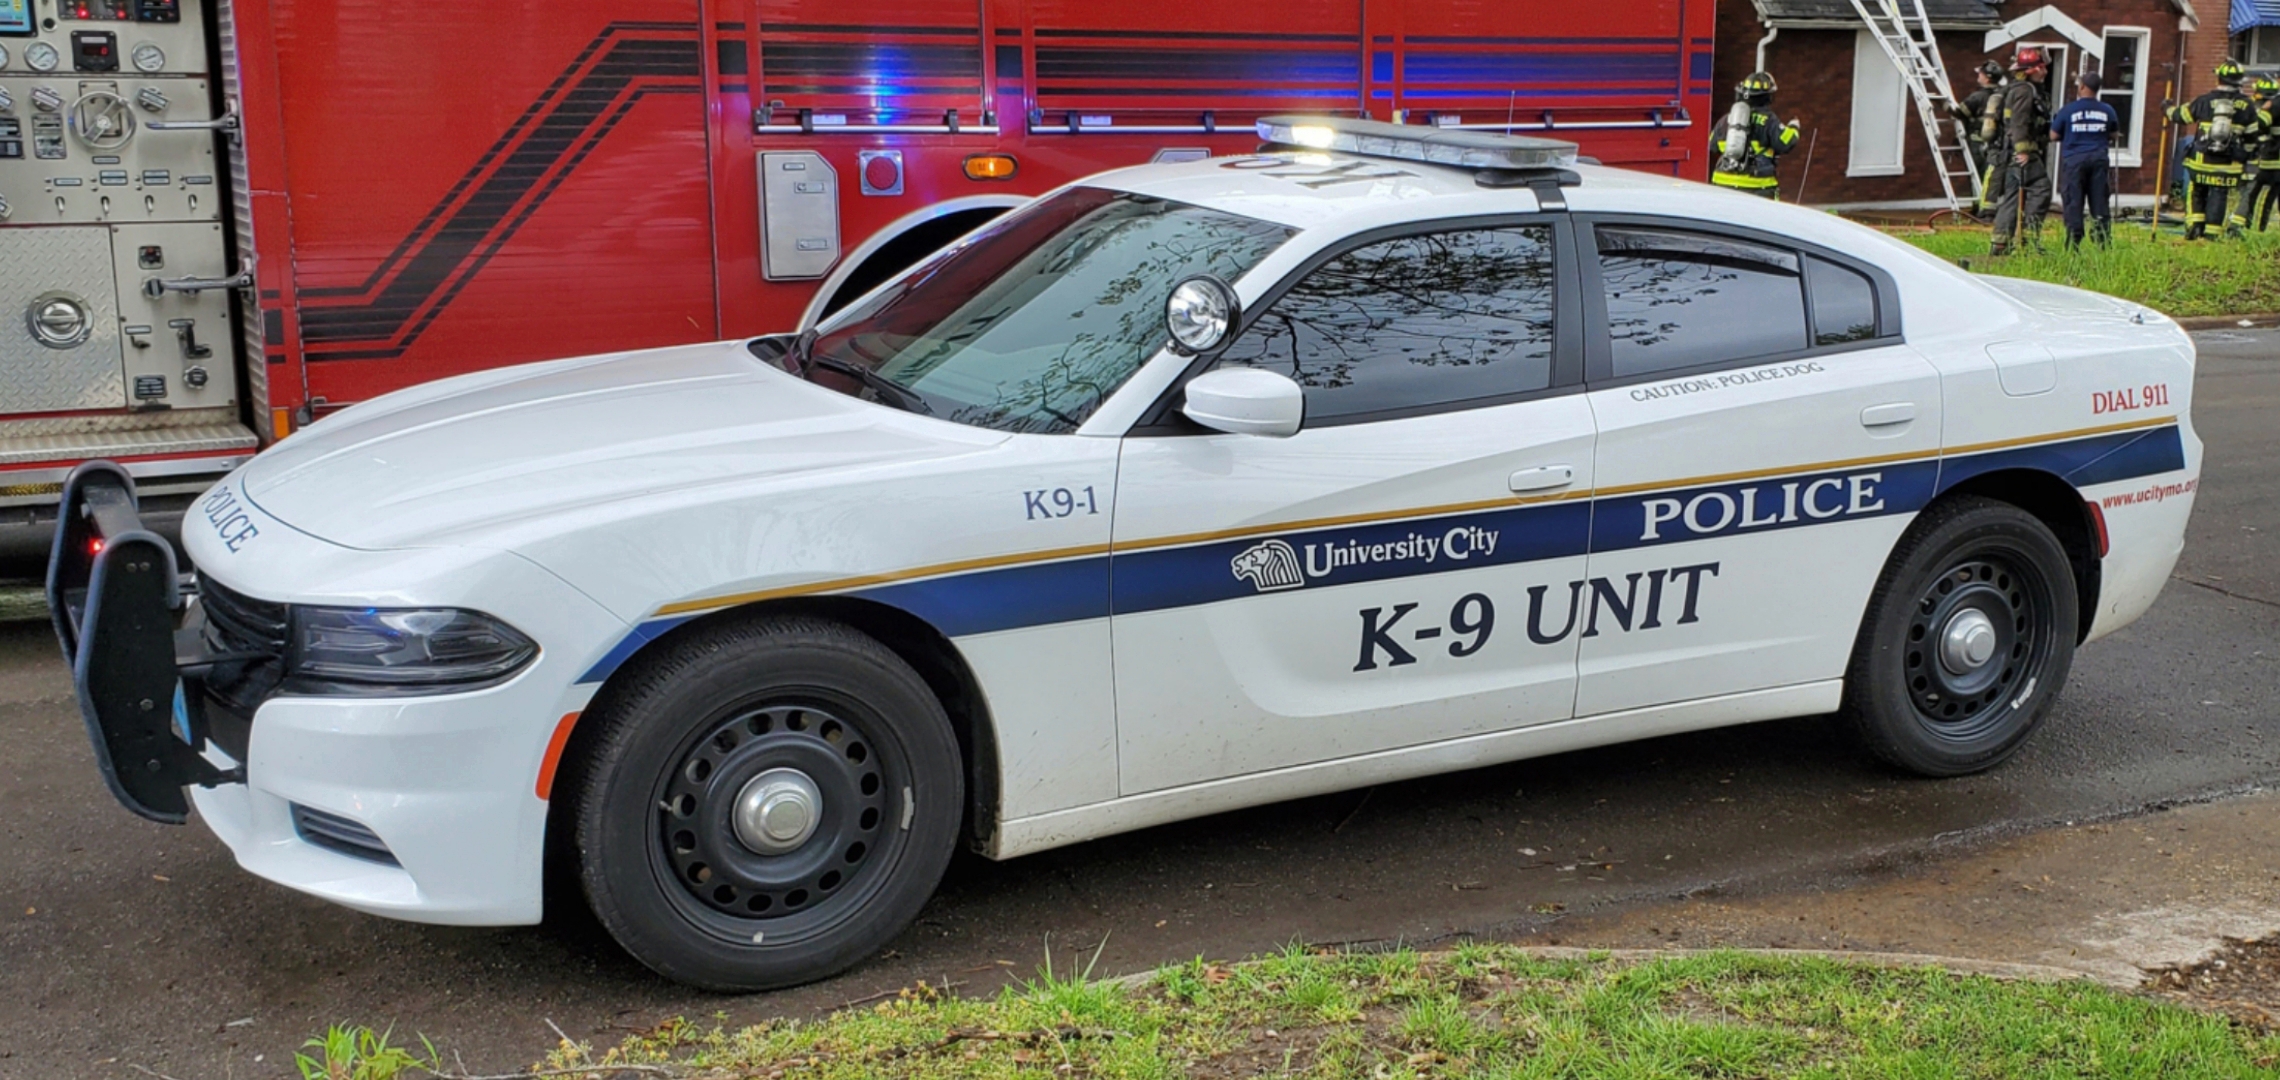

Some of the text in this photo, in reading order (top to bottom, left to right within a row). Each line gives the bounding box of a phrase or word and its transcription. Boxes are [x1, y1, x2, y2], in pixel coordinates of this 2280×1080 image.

[1630, 362, 1825, 402] CAUTION: POLICE DOG
[2092, 383, 2169, 414] DIAL 911
[201, 485, 259, 554] POLICE
[1023, 485, 1099, 520] K9-1
[1640, 472, 1885, 541] POLICE
[1305, 527, 1500, 577] University City
[1352, 561, 1720, 673] K-9 UNIT
